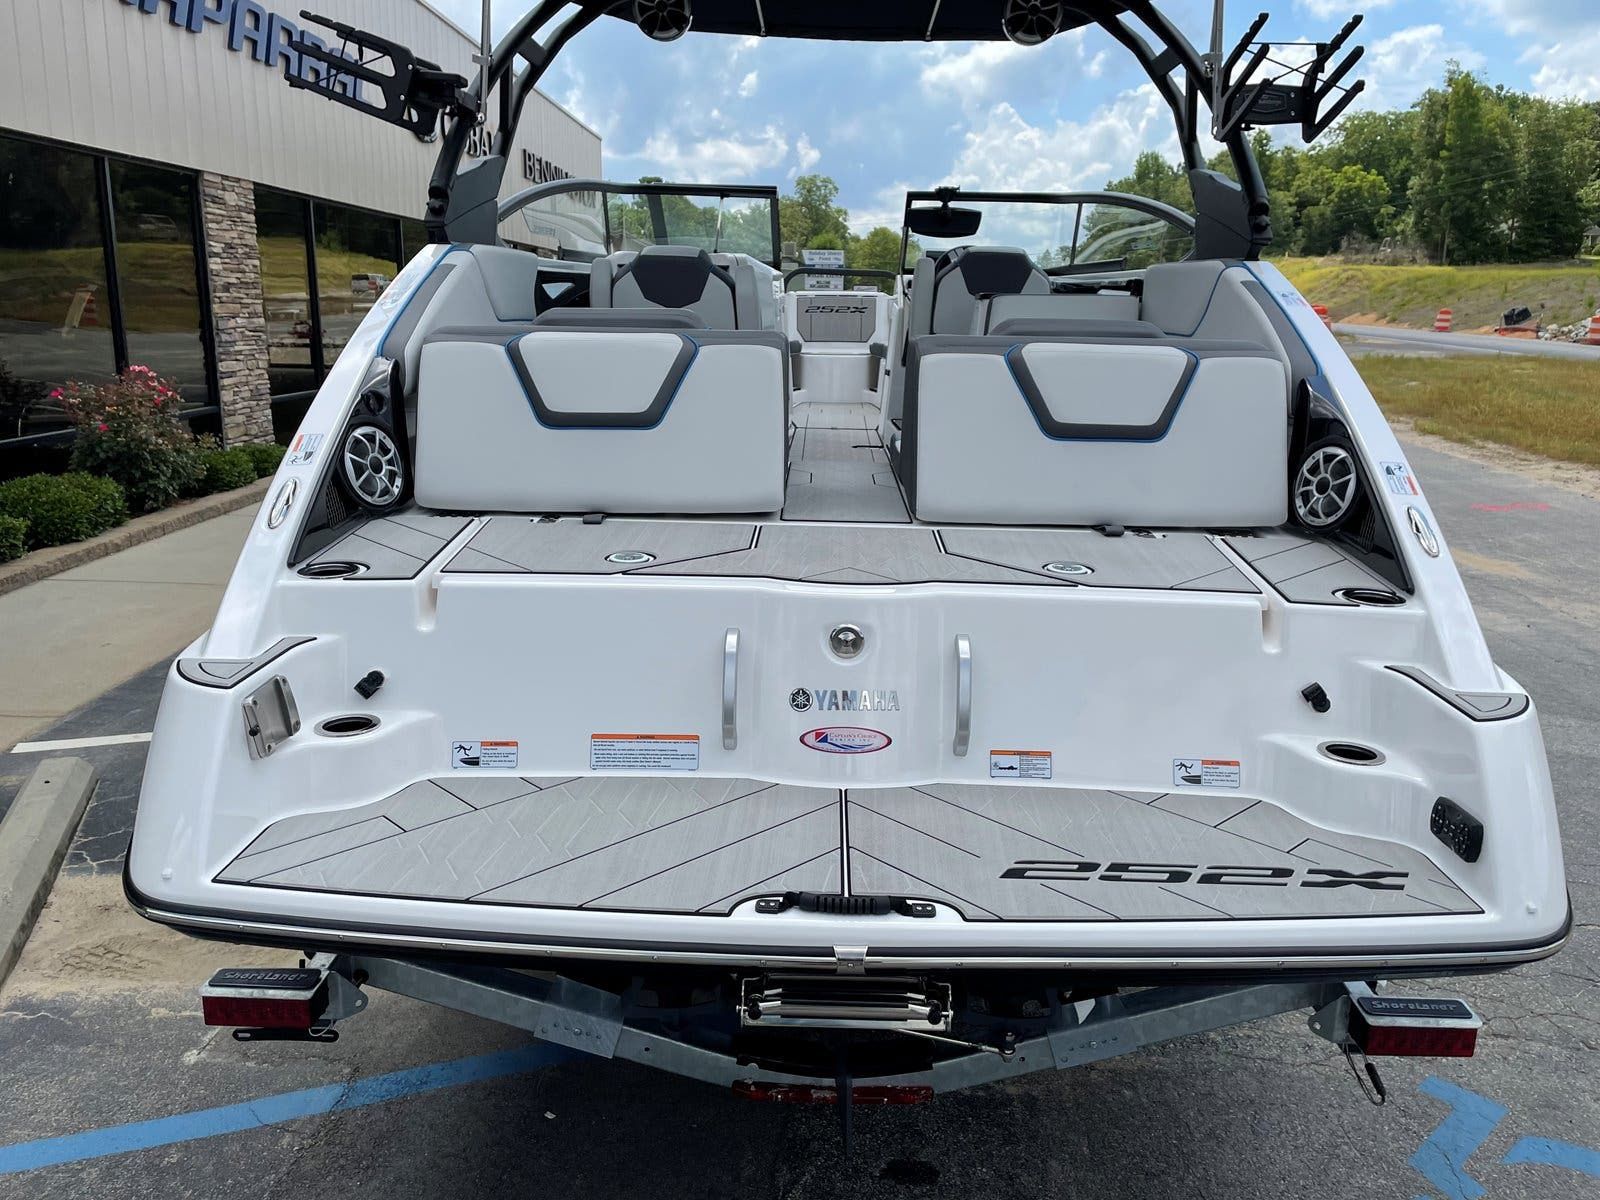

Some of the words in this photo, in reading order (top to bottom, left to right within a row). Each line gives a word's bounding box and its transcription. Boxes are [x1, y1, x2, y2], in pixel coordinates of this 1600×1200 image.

[804, 305, 868, 314] 252X
[814, 690, 901, 712] YAMAHA
[999, 860, 1410, 891] 252X
